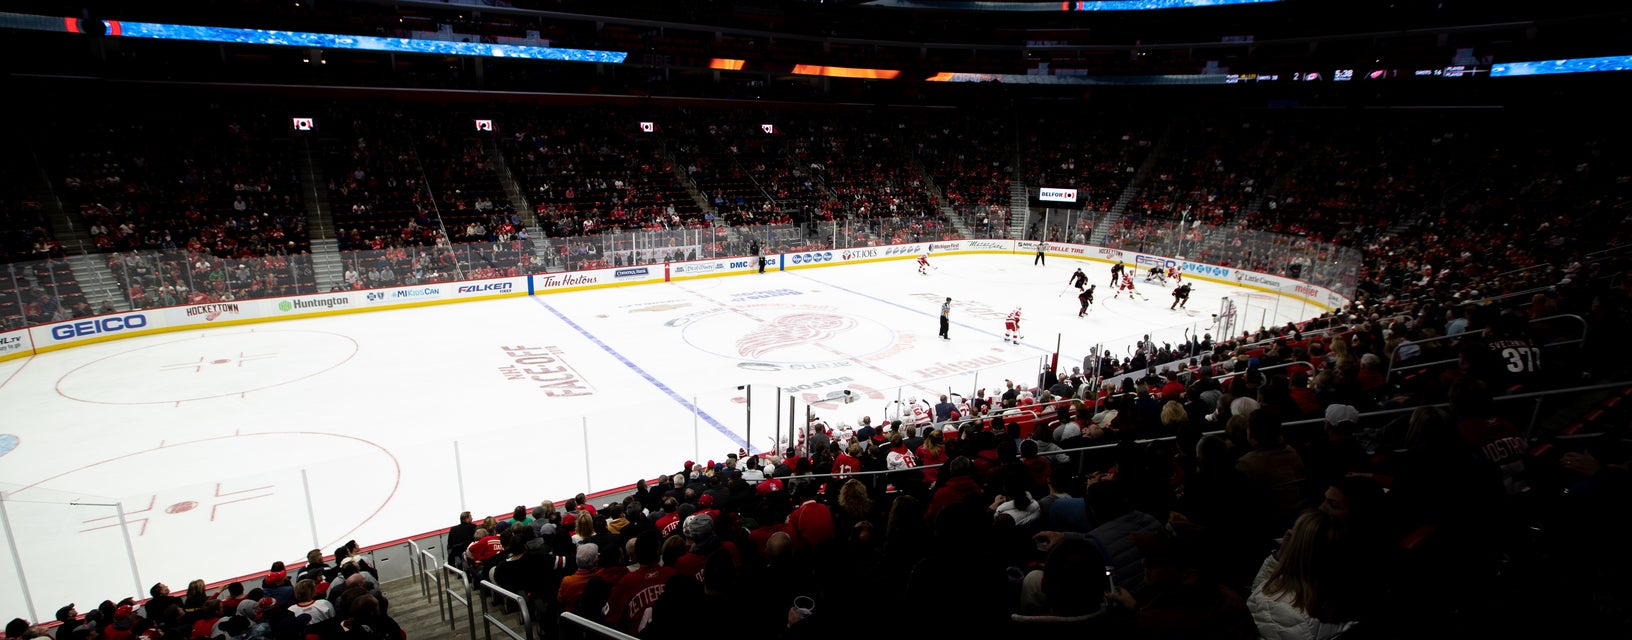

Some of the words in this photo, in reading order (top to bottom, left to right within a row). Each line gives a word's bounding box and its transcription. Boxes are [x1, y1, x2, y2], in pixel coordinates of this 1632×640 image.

[1335, 69, 1353, 77] 5:38
[1050, 245, 1069, 253] BELLE
[1070, 247, 1085, 255] TIRE
[1098, 248, 1123, 257] HOCKEYTOWN
[730, 261, 748, 269] DMC
[543, 275, 560, 288] Tim
[560, 274, 597, 286] Hortons
[1244, 274, 1259, 282] Little
[458, 281, 512, 294] FALKEN
[1294, 285, 1319, 298] meijer
[293, 296, 349, 309] Huntington
[186, 303, 239, 317] HOCKEYTOWN
[51, 313, 147, 341] GEICO
[783, 376, 855, 393] BELFOR
